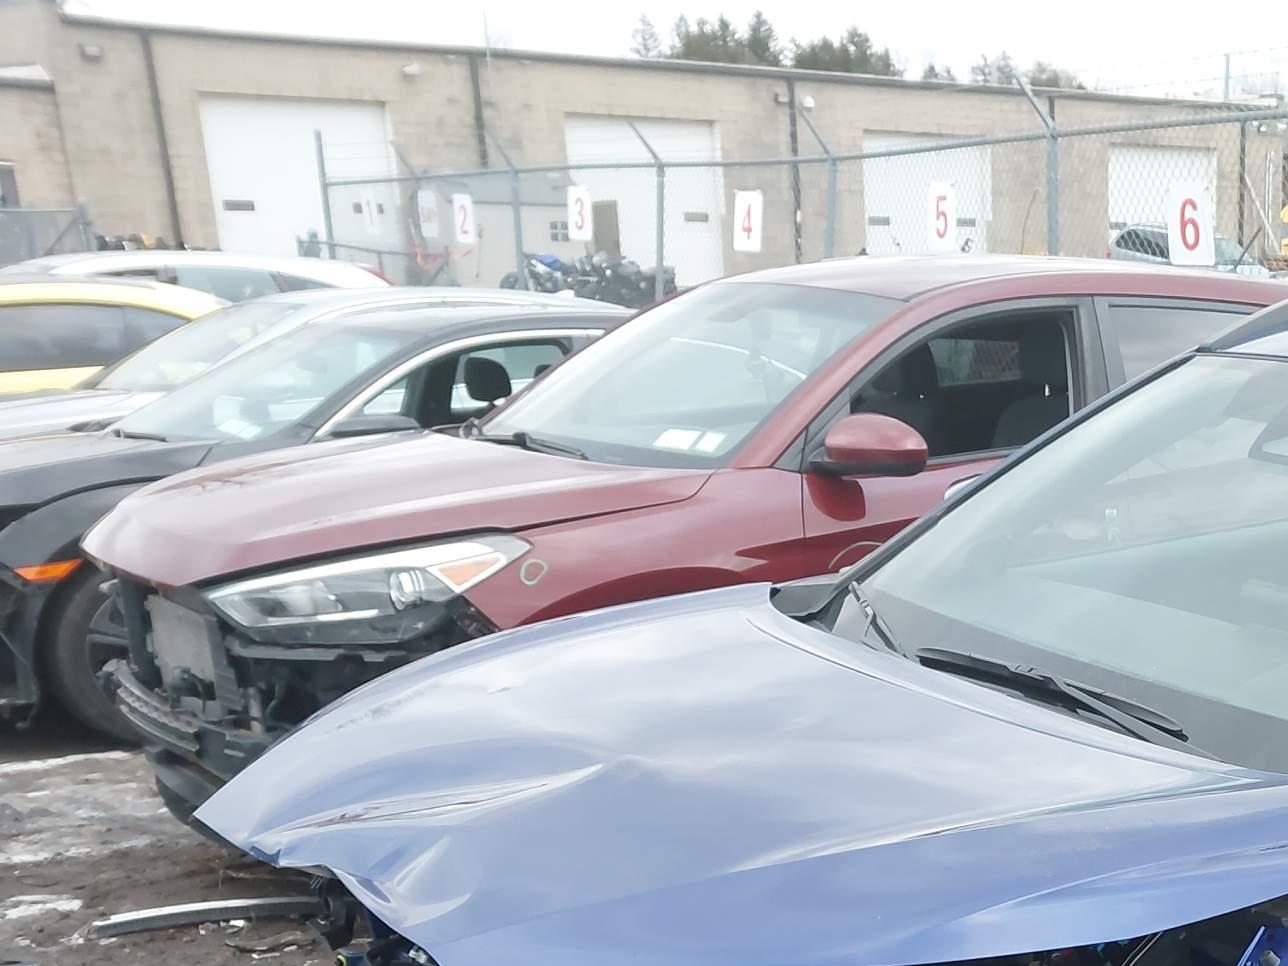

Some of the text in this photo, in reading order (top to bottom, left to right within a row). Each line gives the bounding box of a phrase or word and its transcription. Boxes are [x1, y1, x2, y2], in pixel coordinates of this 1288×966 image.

[458, 203, 469, 235] 2
[575, 197, 585, 231] 3
[741, 203, 753, 240] 4
[935, 195, 948, 239] 5
[1179, 197, 1201, 252] 6
